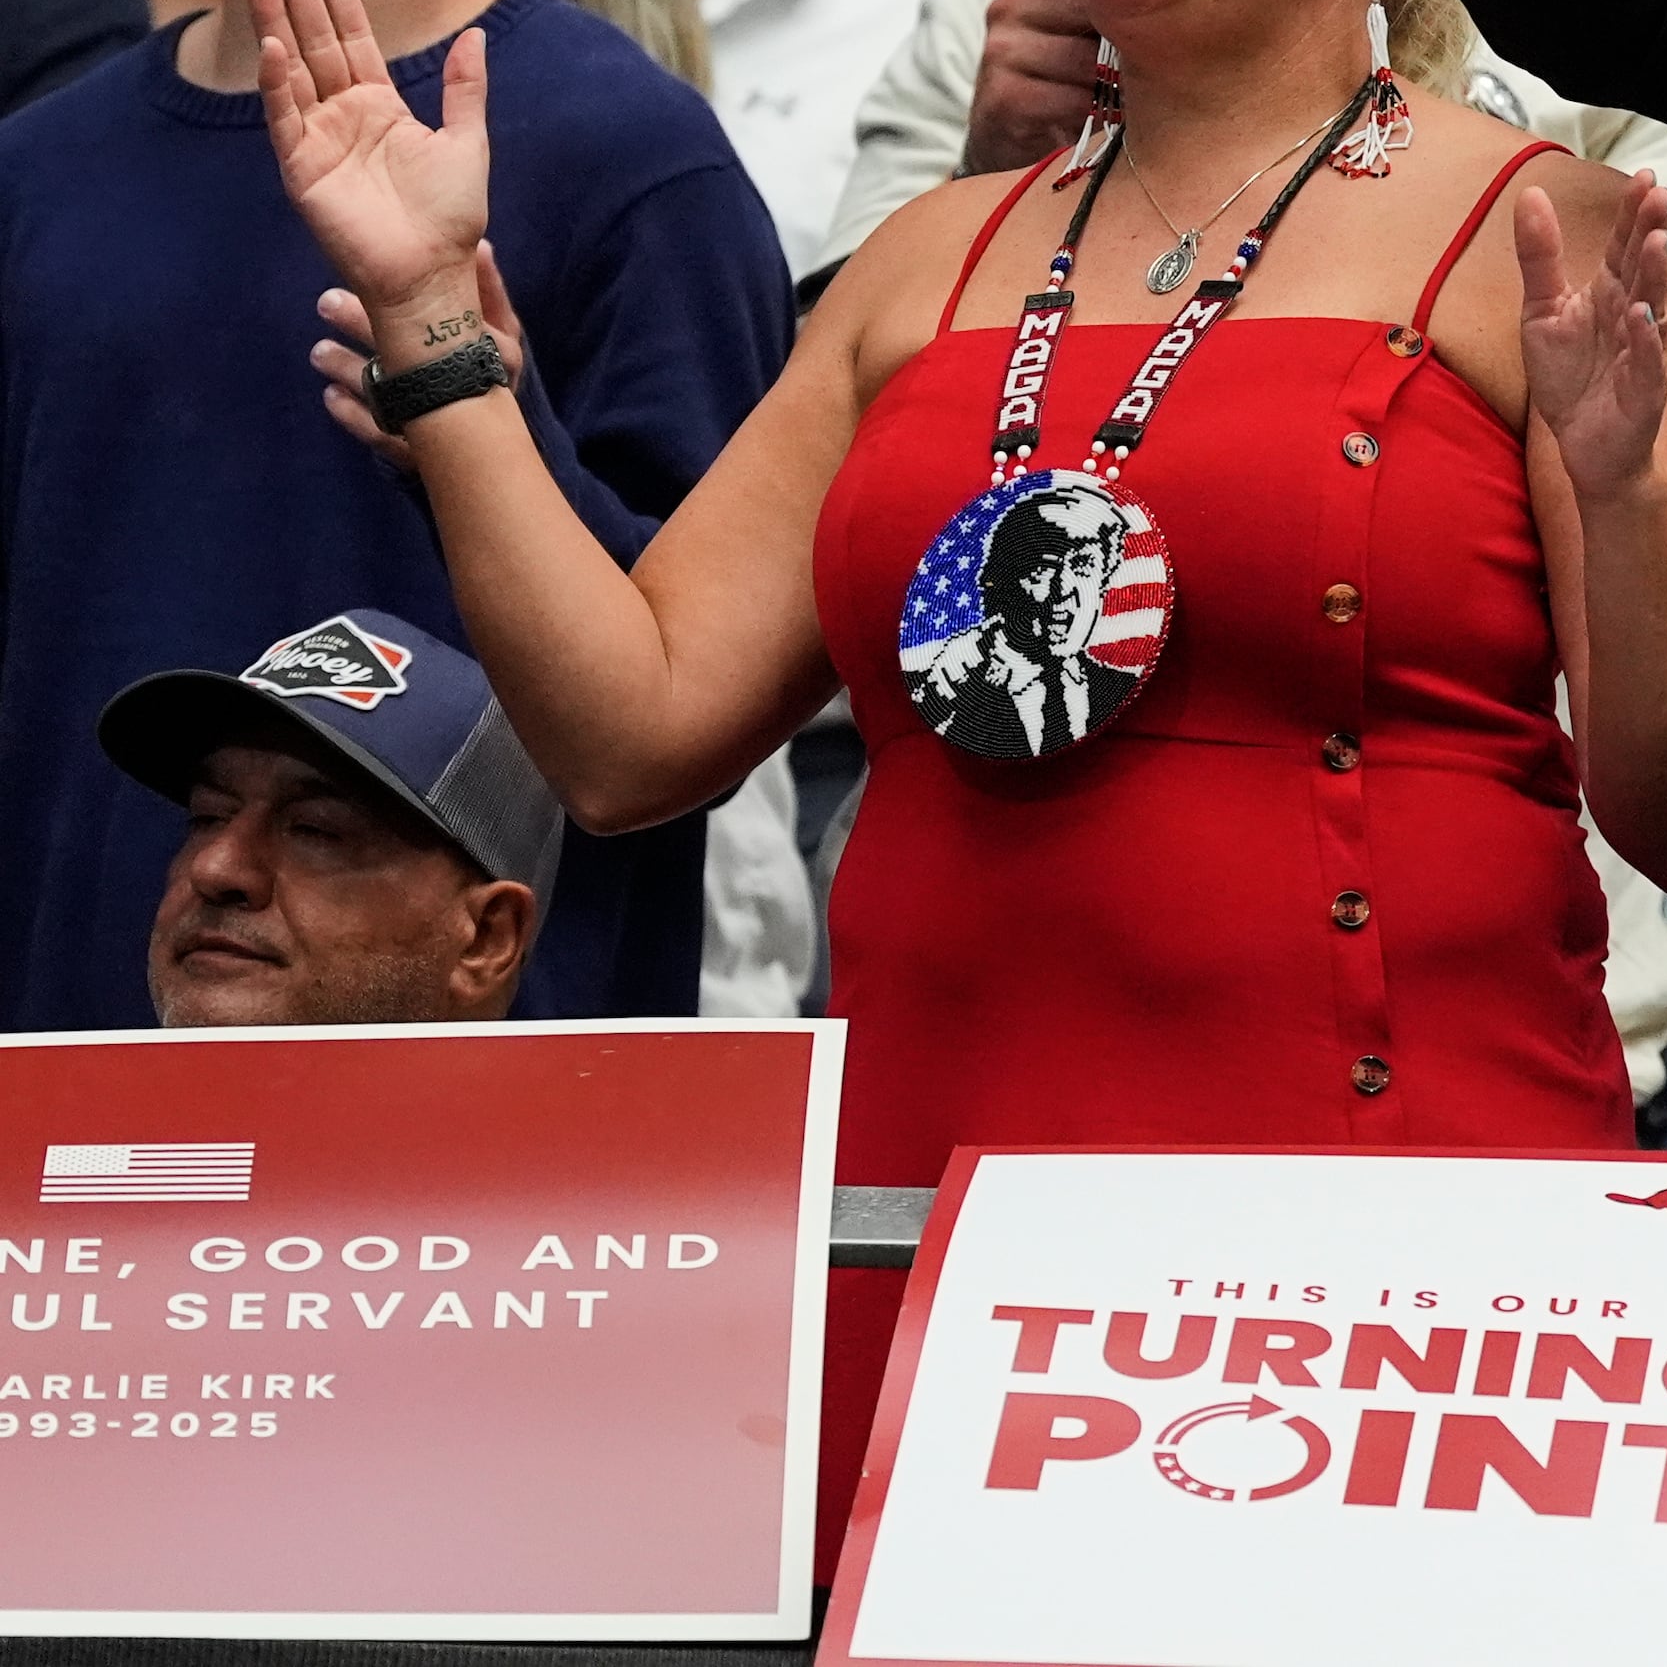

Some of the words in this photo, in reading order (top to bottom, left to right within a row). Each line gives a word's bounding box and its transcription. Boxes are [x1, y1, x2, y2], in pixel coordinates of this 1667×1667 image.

[998, 311, 1064, 431] MAGA
[1111, 300, 1222, 423] MAGA
[0, 1237, 137, 1279] NE,
[188, 1234, 471, 1273] GOOD
[521, 1234, 721, 1271] AND
[10, 1293, 113, 1331] UL
[164, 1289, 610, 1331] SERVANT
[1167, 1278, 1328, 1305] THIS
[1379, 1288, 1439, 1311] IS
[1491, 1294, 1630, 1320] OUR
[0, 1373, 169, 1401] ARLIE
[200, 1373, 339, 1401] KIRK
[0, 1410, 279, 1439] 993-2025
